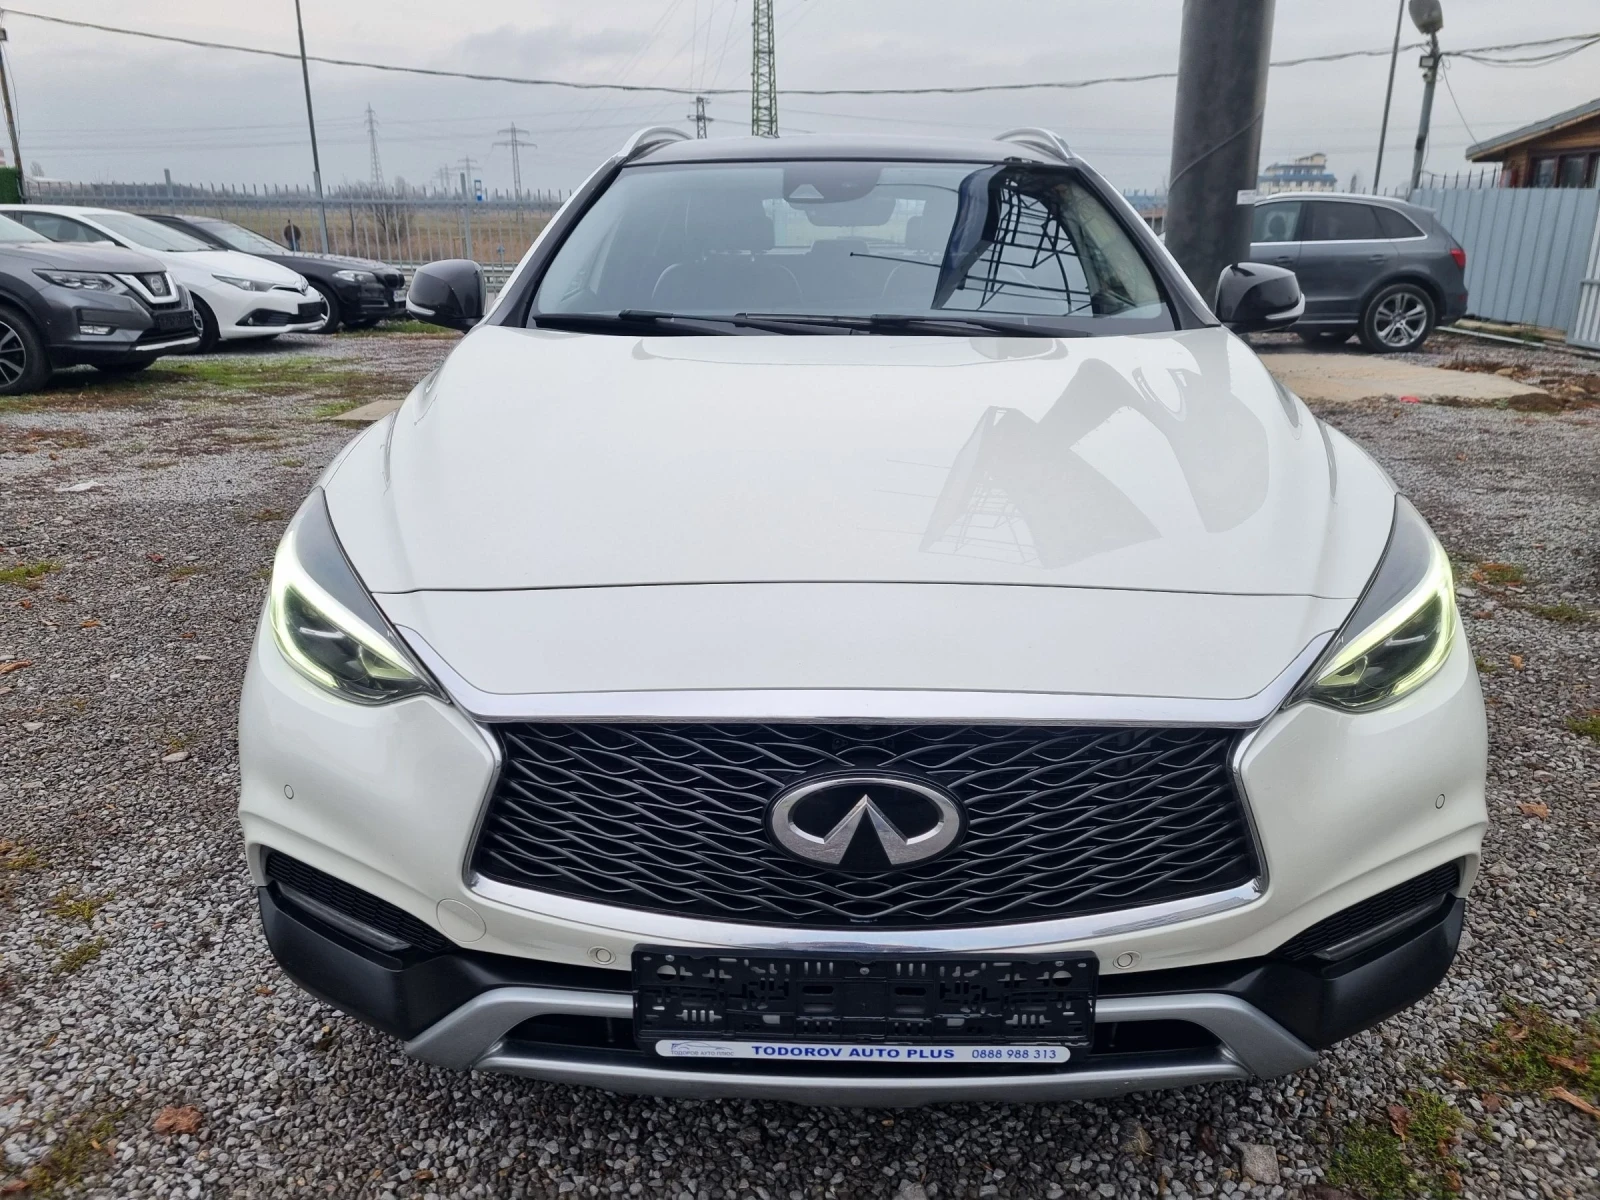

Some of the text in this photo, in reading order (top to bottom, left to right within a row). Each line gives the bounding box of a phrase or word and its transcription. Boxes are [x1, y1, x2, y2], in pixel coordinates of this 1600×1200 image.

[751, 1045, 955, 1059] TODOROV AUTO PLUS
[971, 1049, 1057, 1059] 0888 988 313
